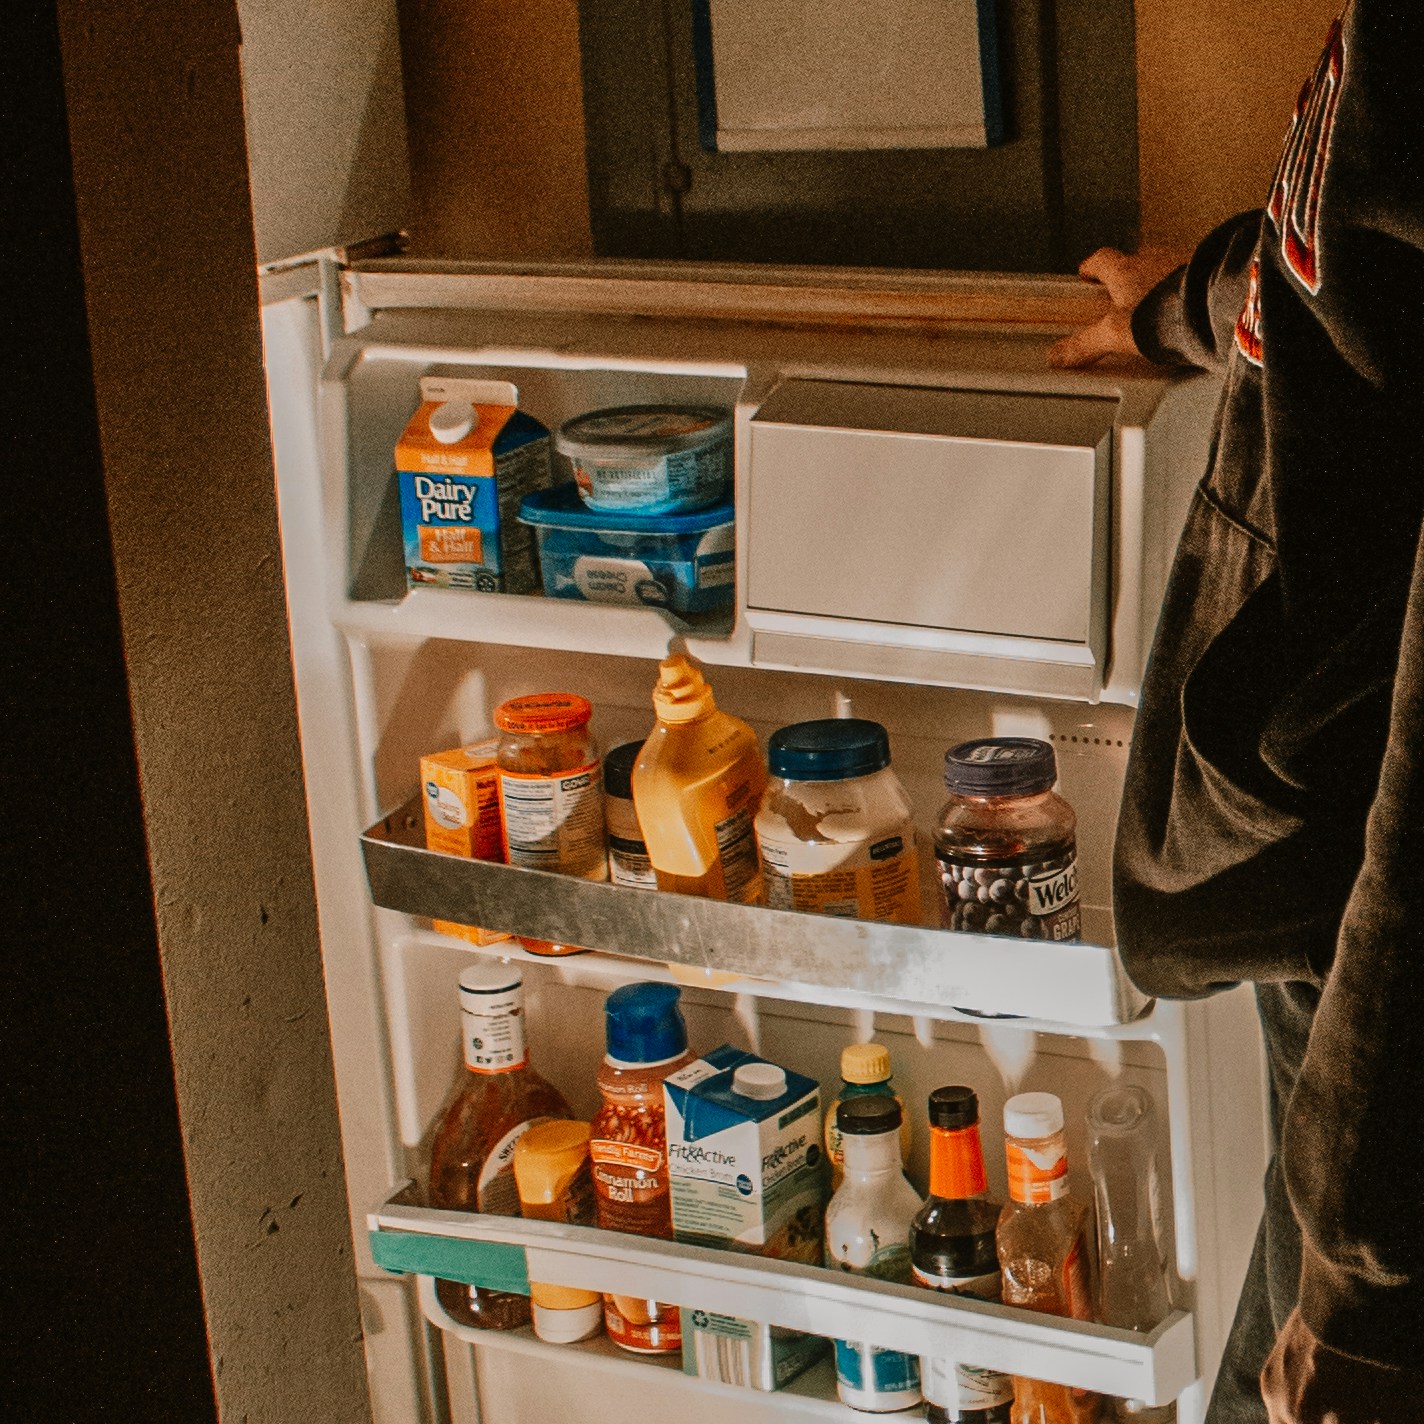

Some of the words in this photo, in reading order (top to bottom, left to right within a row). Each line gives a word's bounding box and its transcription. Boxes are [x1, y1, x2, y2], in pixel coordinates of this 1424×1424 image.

[414, 476, 476, 504] Dairy
[420, 498, 473, 523] Pure
[608, 1185, 635, 1203] Roll
